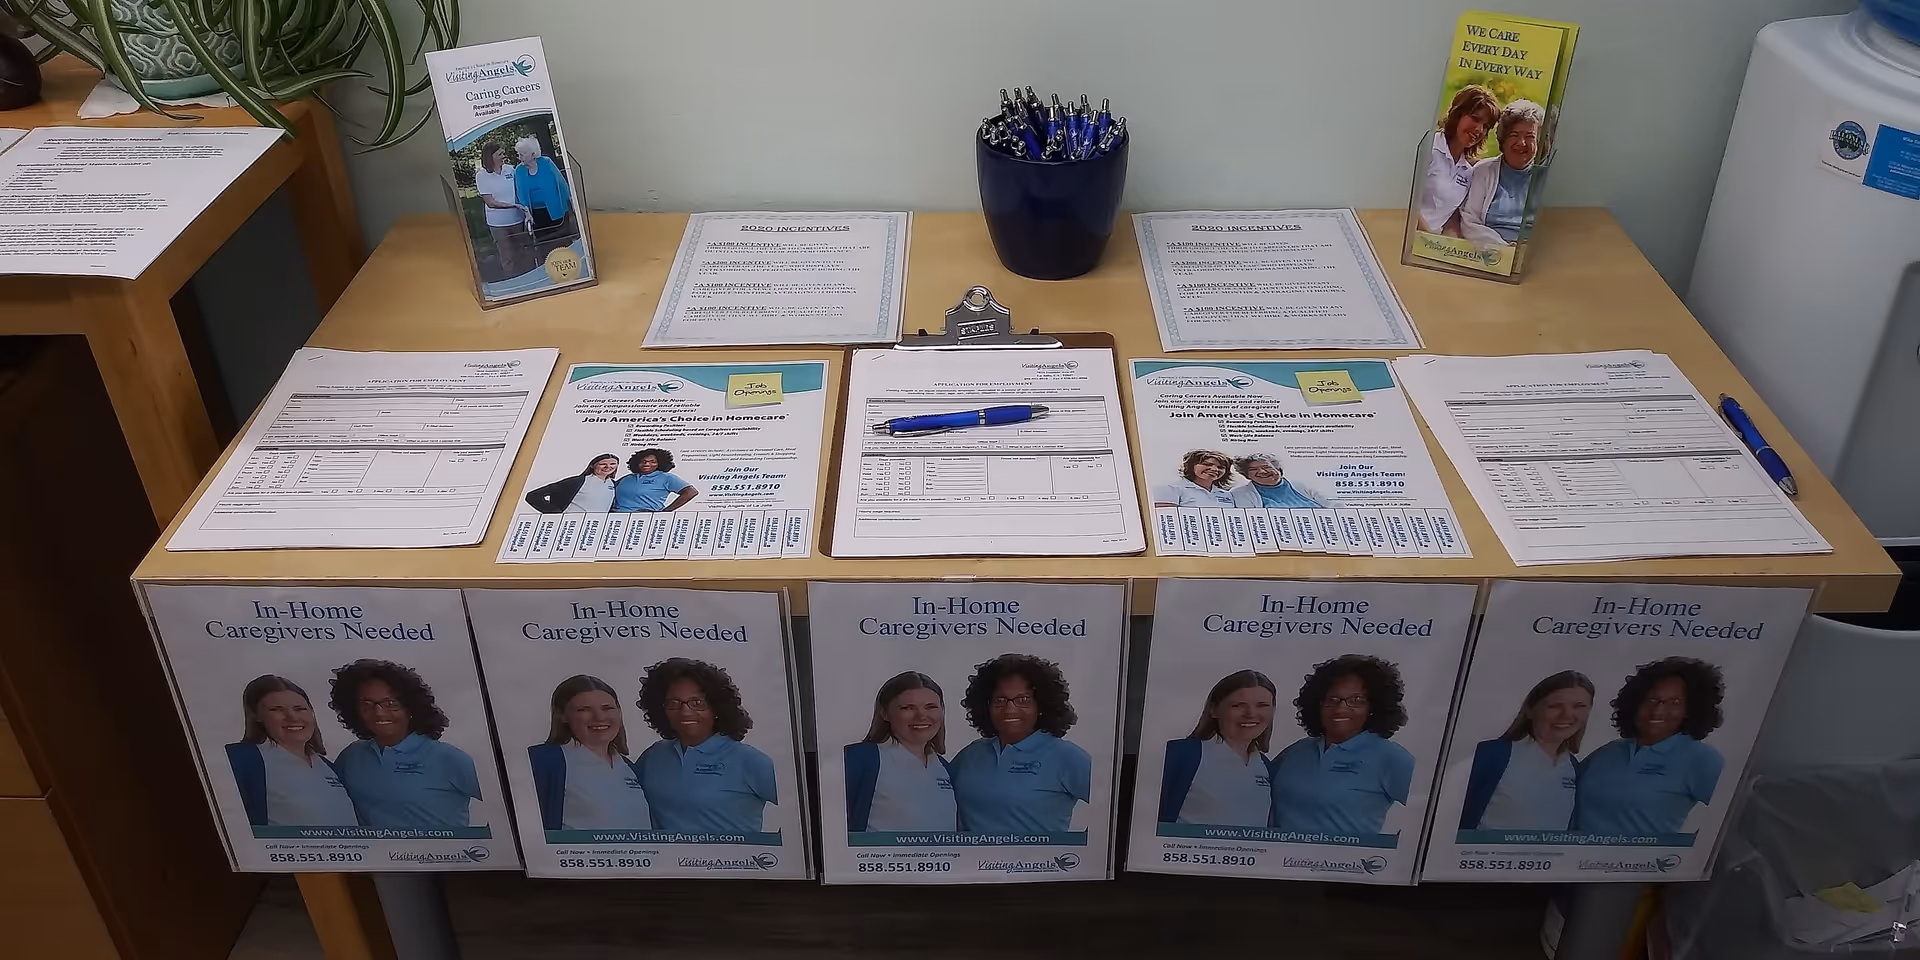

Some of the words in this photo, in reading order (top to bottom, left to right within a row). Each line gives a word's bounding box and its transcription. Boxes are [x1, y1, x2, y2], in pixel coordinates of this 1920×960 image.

[1467, 24, 1486, 38] WE
[1488, 27, 1520, 42] CARE
[1462, 41, 1499, 56] EVERY
[1502, 46, 1528, 61] DAY
[1459, 56, 1472, 69] IN
[1473, 59, 1511, 75] EVERY
[1514, 66, 1543, 81] WAY
[466, 89, 501, 103] Caring
[502, 84, 541, 98] Careers
[473, 101, 502, 111] Rewarding
[503, 97, 529, 107] Positions
[475, 107, 500, 117] Available
[1227, 224, 1302, 232] INCENTIVES
[670, 414, 709, 422] Choice
[711, 414, 723, 422] in
[1197, 411, 1254, 419] America's
[1257, 411, 1297, 419] Choice
[252, 600, 363, 620] In-Home
[570, 601, 680, 621] In-Home
[912, 596, 1020, 615] In-Home
[1260, 594, 1370, 614] In-Home
[1592, 596, 1702, 617] In-Home
[205, 621, 336, 644] Caregivers
[343, 622, 435, 641] Needed
[521, 622, 651, 644] Caregivers
[659, 621, 748, 643] Needed
[859, 617, 988, 640] Caregivers
[996, 617, 1087, 637] Needed
[1203, 614, 1333, 638] Caregivers
[1340, 616, 1433, 637] Needed
[1533, 616, 1662, 639] Caregivers
[1671, 619, 1765, 641] Needed
[300, 827, 454, 839] www.VisitingAngels.com
[592, 832, 745, 844] www.VisitingAngels.com
[896, 833, 1050, 845] www.VisitingAngels.com
[1204, 828, 1360, 845] www.VisitingAngels.com
[1504, 832, 1657, 845] www.VisitingAngels.com
[270, 852, 363, 863] 858.551.8910
[559, 857, 652, 868] 858.551.8910
[1162, 852, 1256, 867] 858.551.8910
[1459, 859, 1552, 871] 858.551.8910
[858, 862, 951, 872] 858.551.8910
